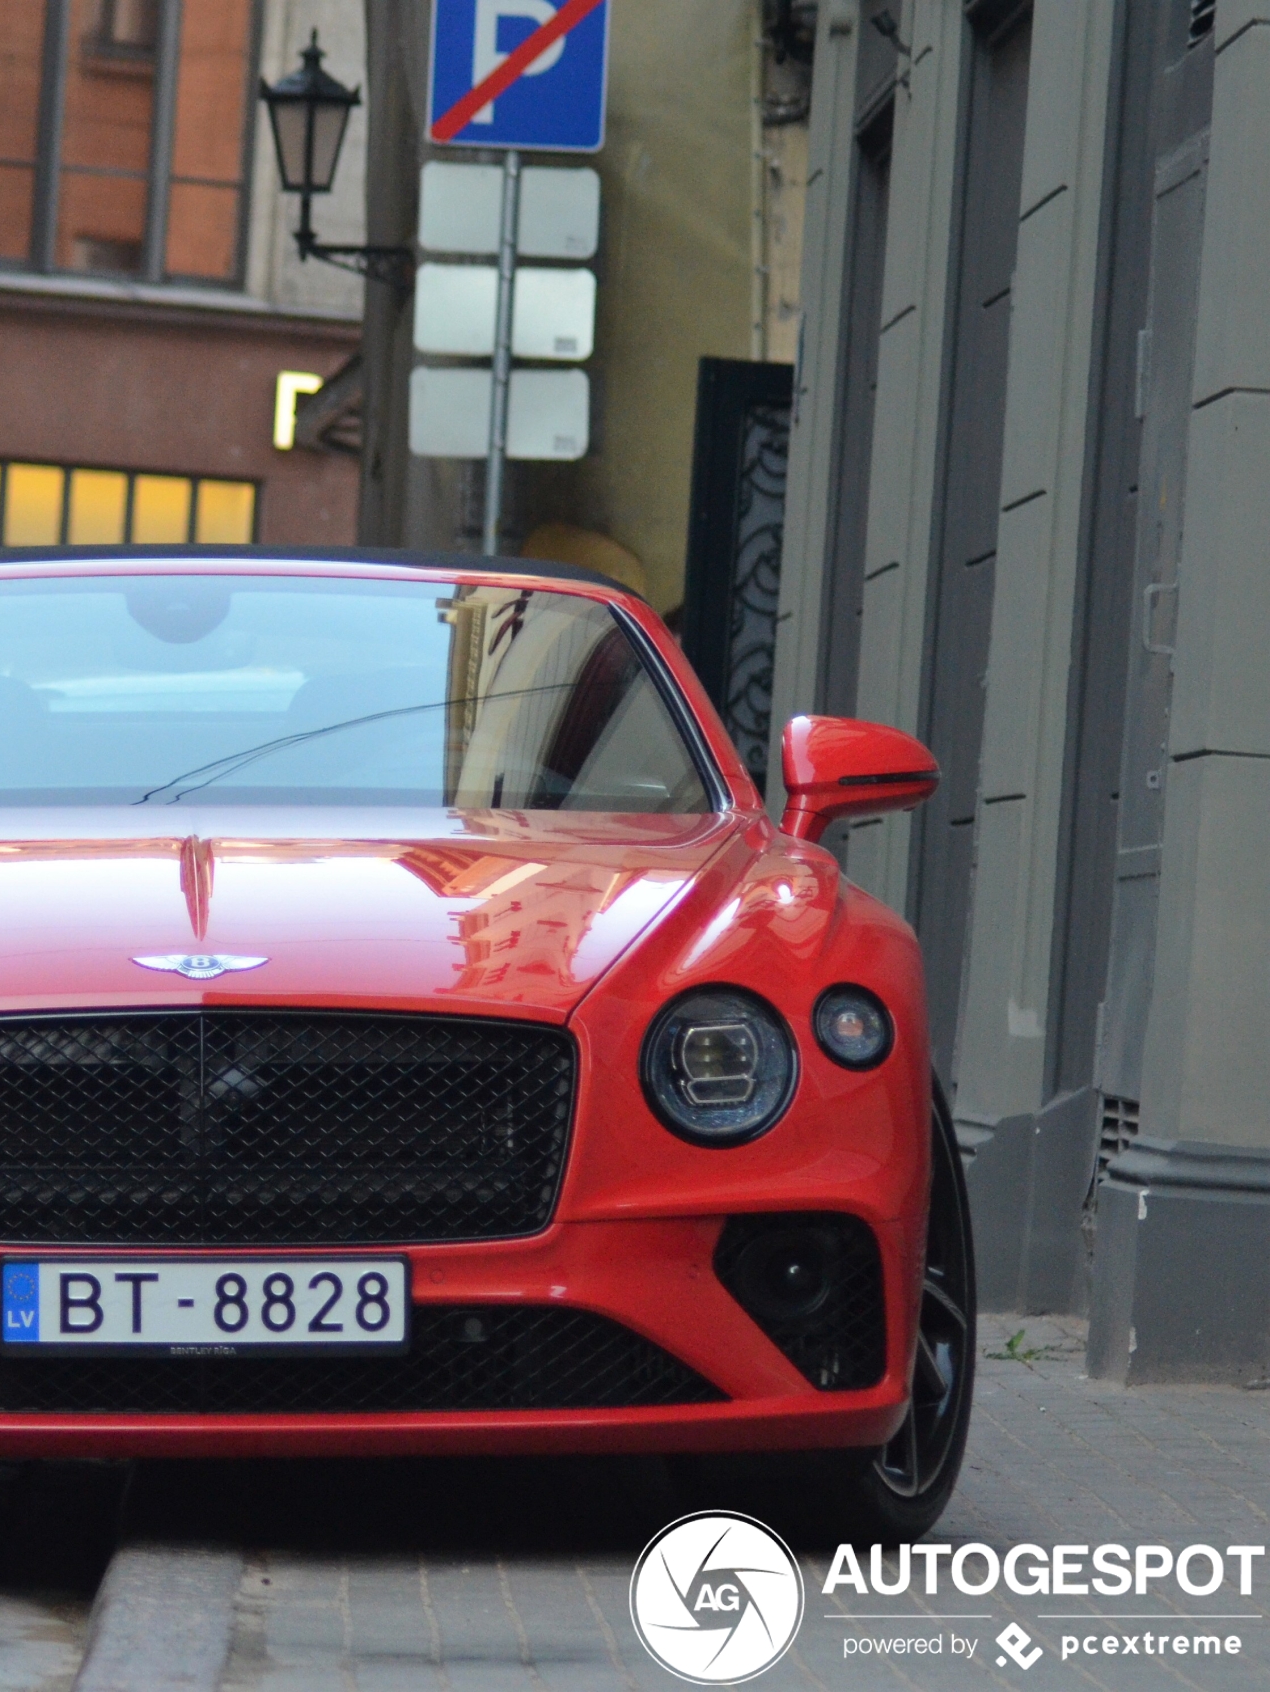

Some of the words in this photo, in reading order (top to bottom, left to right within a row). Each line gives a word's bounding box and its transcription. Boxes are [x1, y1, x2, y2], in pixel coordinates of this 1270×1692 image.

[471, 0, 567, 124] P
[191, 956, 211, 968] B
[58, 1271, 391, 1334] BT-8828
[7, 1310, 34, 1328] LV
[170, 1346, 212, 1355] BENTLEY
